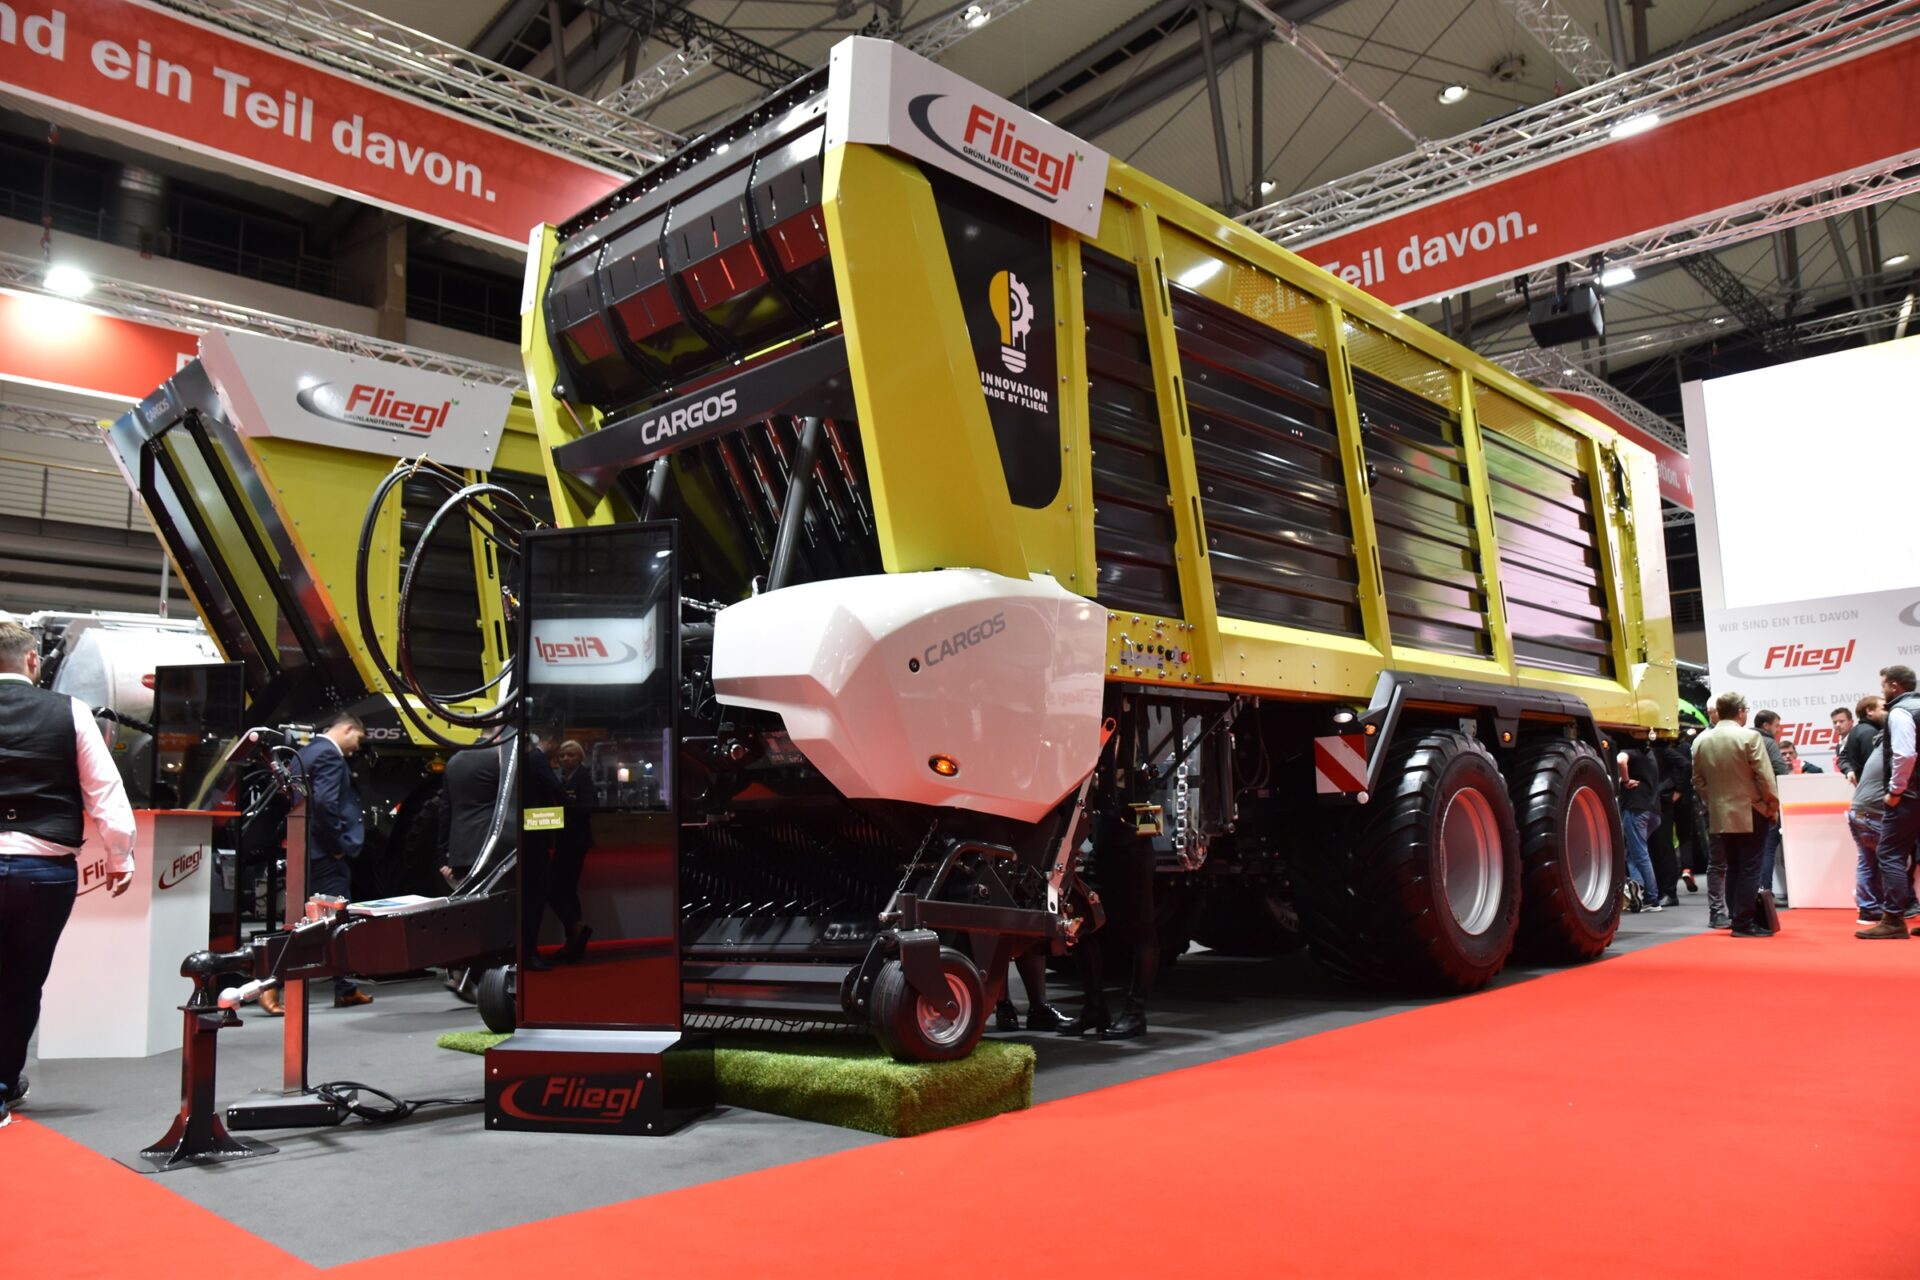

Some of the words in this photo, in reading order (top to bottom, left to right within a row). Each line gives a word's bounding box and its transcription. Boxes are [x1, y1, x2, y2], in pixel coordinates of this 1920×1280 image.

[91, 39, 192, 103] ein
[213, 66, 313, 142] Teil
[332, 114, 496, 202] davon.
[963, 104, 1075, 196] Fliegl
[963, 145, 1030, 183] GRÜNLANDTECHNIK
[1397, 211, 1537, 274] davon.
[981, 371, 1048, 403] INNOVATION
[982, 385, 1005, 400] MADE
[1008, 393, 1019, 404] BY
[1021, 398, 1048, 413] FLIEGL
[345, 384, 451, 433] Fliegl
[641, 388, 737, 445] CARGOS
[924, 612, 1006, 667] CARGOS
[1719, 622, 1738, 633] WIR
[1742, 619, 1768, 631] SIND
[1772, 616, 1790, 627] EIN
[1793, 614, 1816, 625] TEIL
[1820, 610, 1859, 622] DAVON
[1764, 639, 1856, 671] Fliegl
[1753, 699, 1778, 710] SIND
[1782, 697, 1800, 708] EIN
[1804, 695, 1827, 706] TEIL
[172, 843, 202, 878] Fliegl
[540, 1077, 645, 1117] Fliegl
